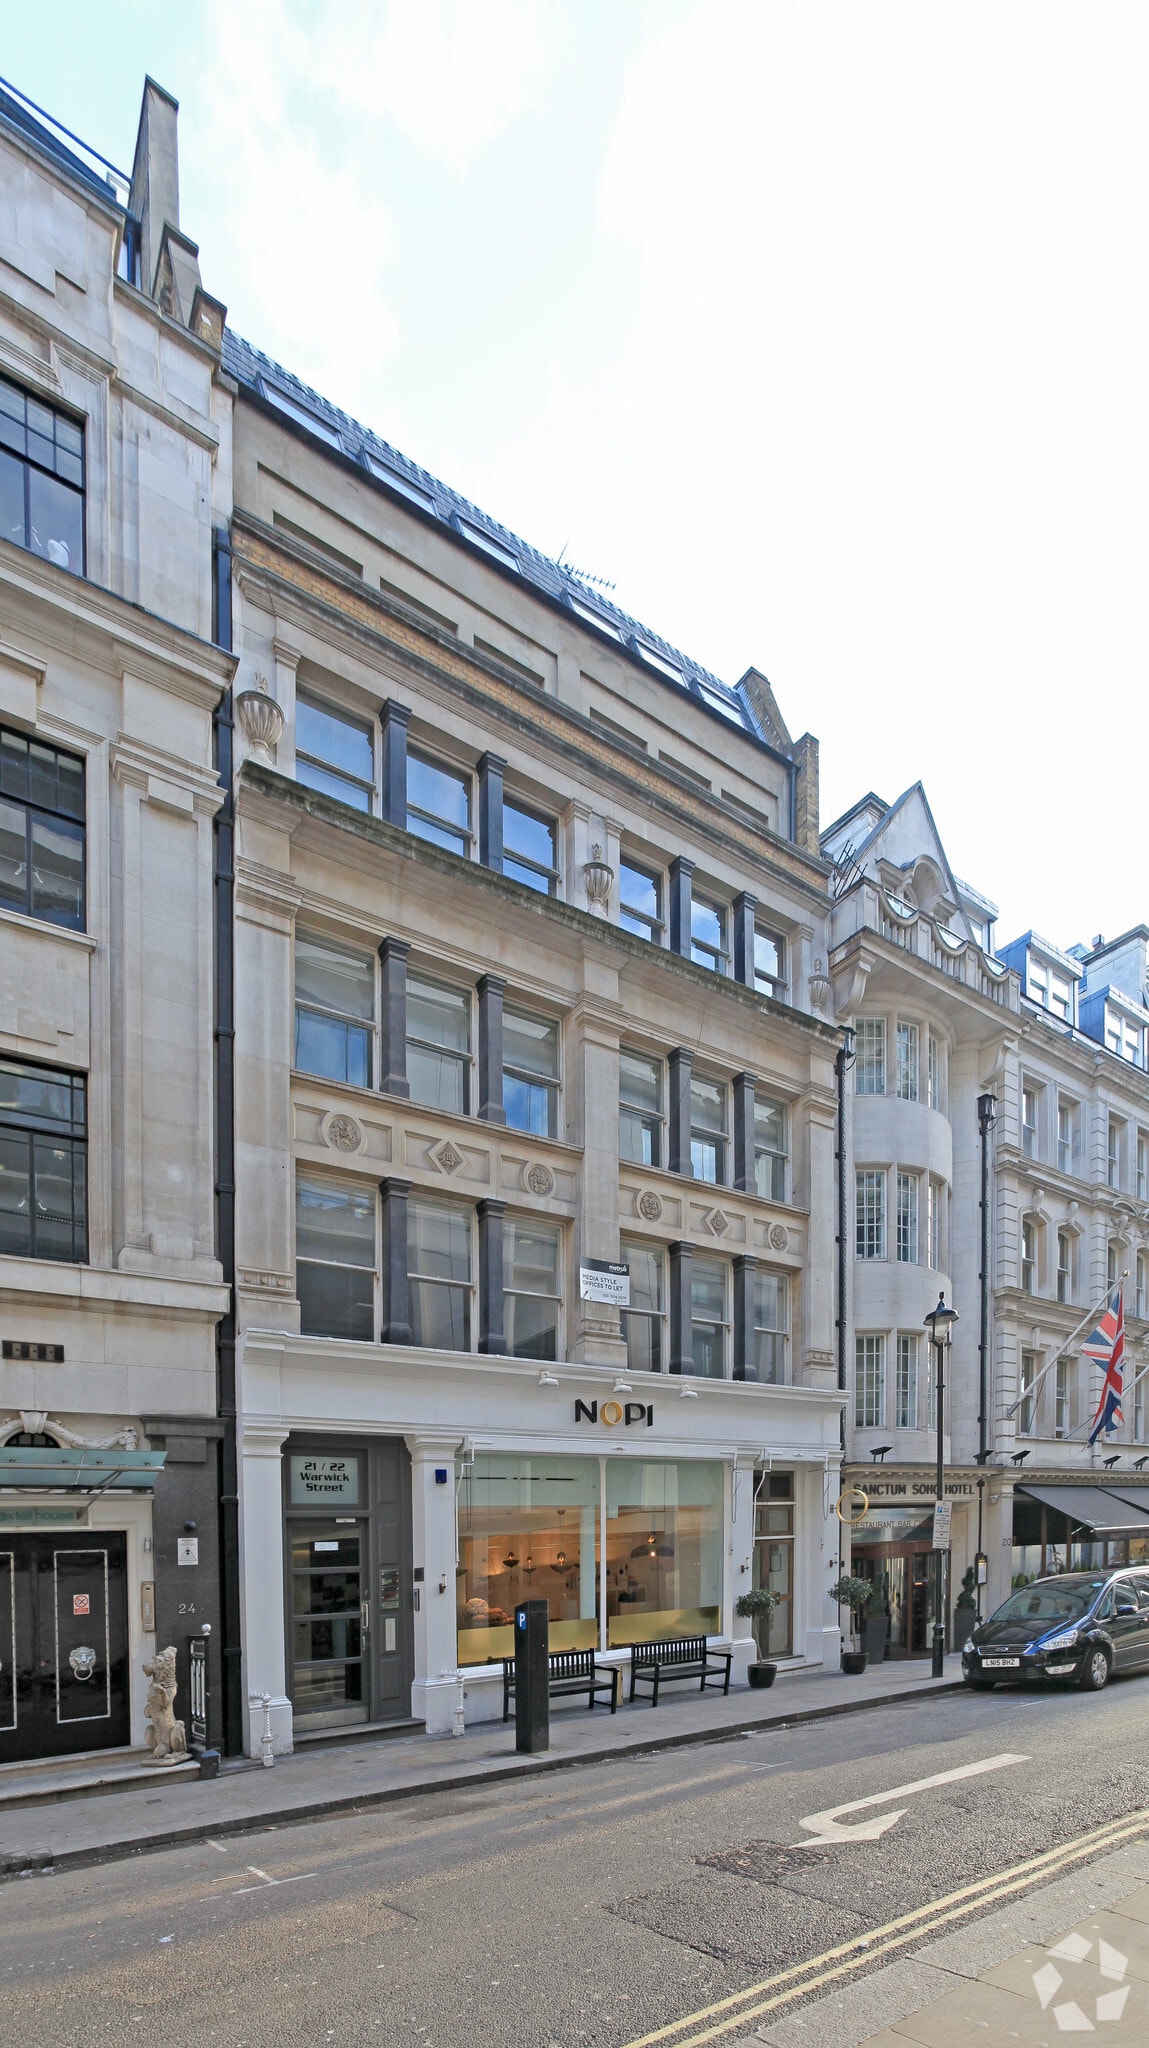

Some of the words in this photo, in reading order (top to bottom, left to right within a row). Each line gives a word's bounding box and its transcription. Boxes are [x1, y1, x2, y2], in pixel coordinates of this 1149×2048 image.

[582, 1274, 599, 1282] MEDIA
[600, 1277, 617, 1285] STYLE
[582, 1280, 604, 1288] OFFICES
[575, 1398, 653, 1427] NOPI
[304, 1462, 316, 1471] 21
[321, 1462, 326, 1471] /
[329, 1462, 345, 1471] 22
[300, 1472, 350, 1482] Warwick
[306, 1482, 344, 1492] Street
[853, 1484, 907, 1495] SANCTUM
[945, 1484, 975, 1495] HOTEL
[35, 1510, 74, 1520] house
[851, 1521, 895, 1529] RESTAURANT
[898, 1520, 911, 1528] BAR
[1002, 1538, 1012, 1546] 20
[179, 1603, 196, 1614] 24
[519, 1613, 525, 1627] P
